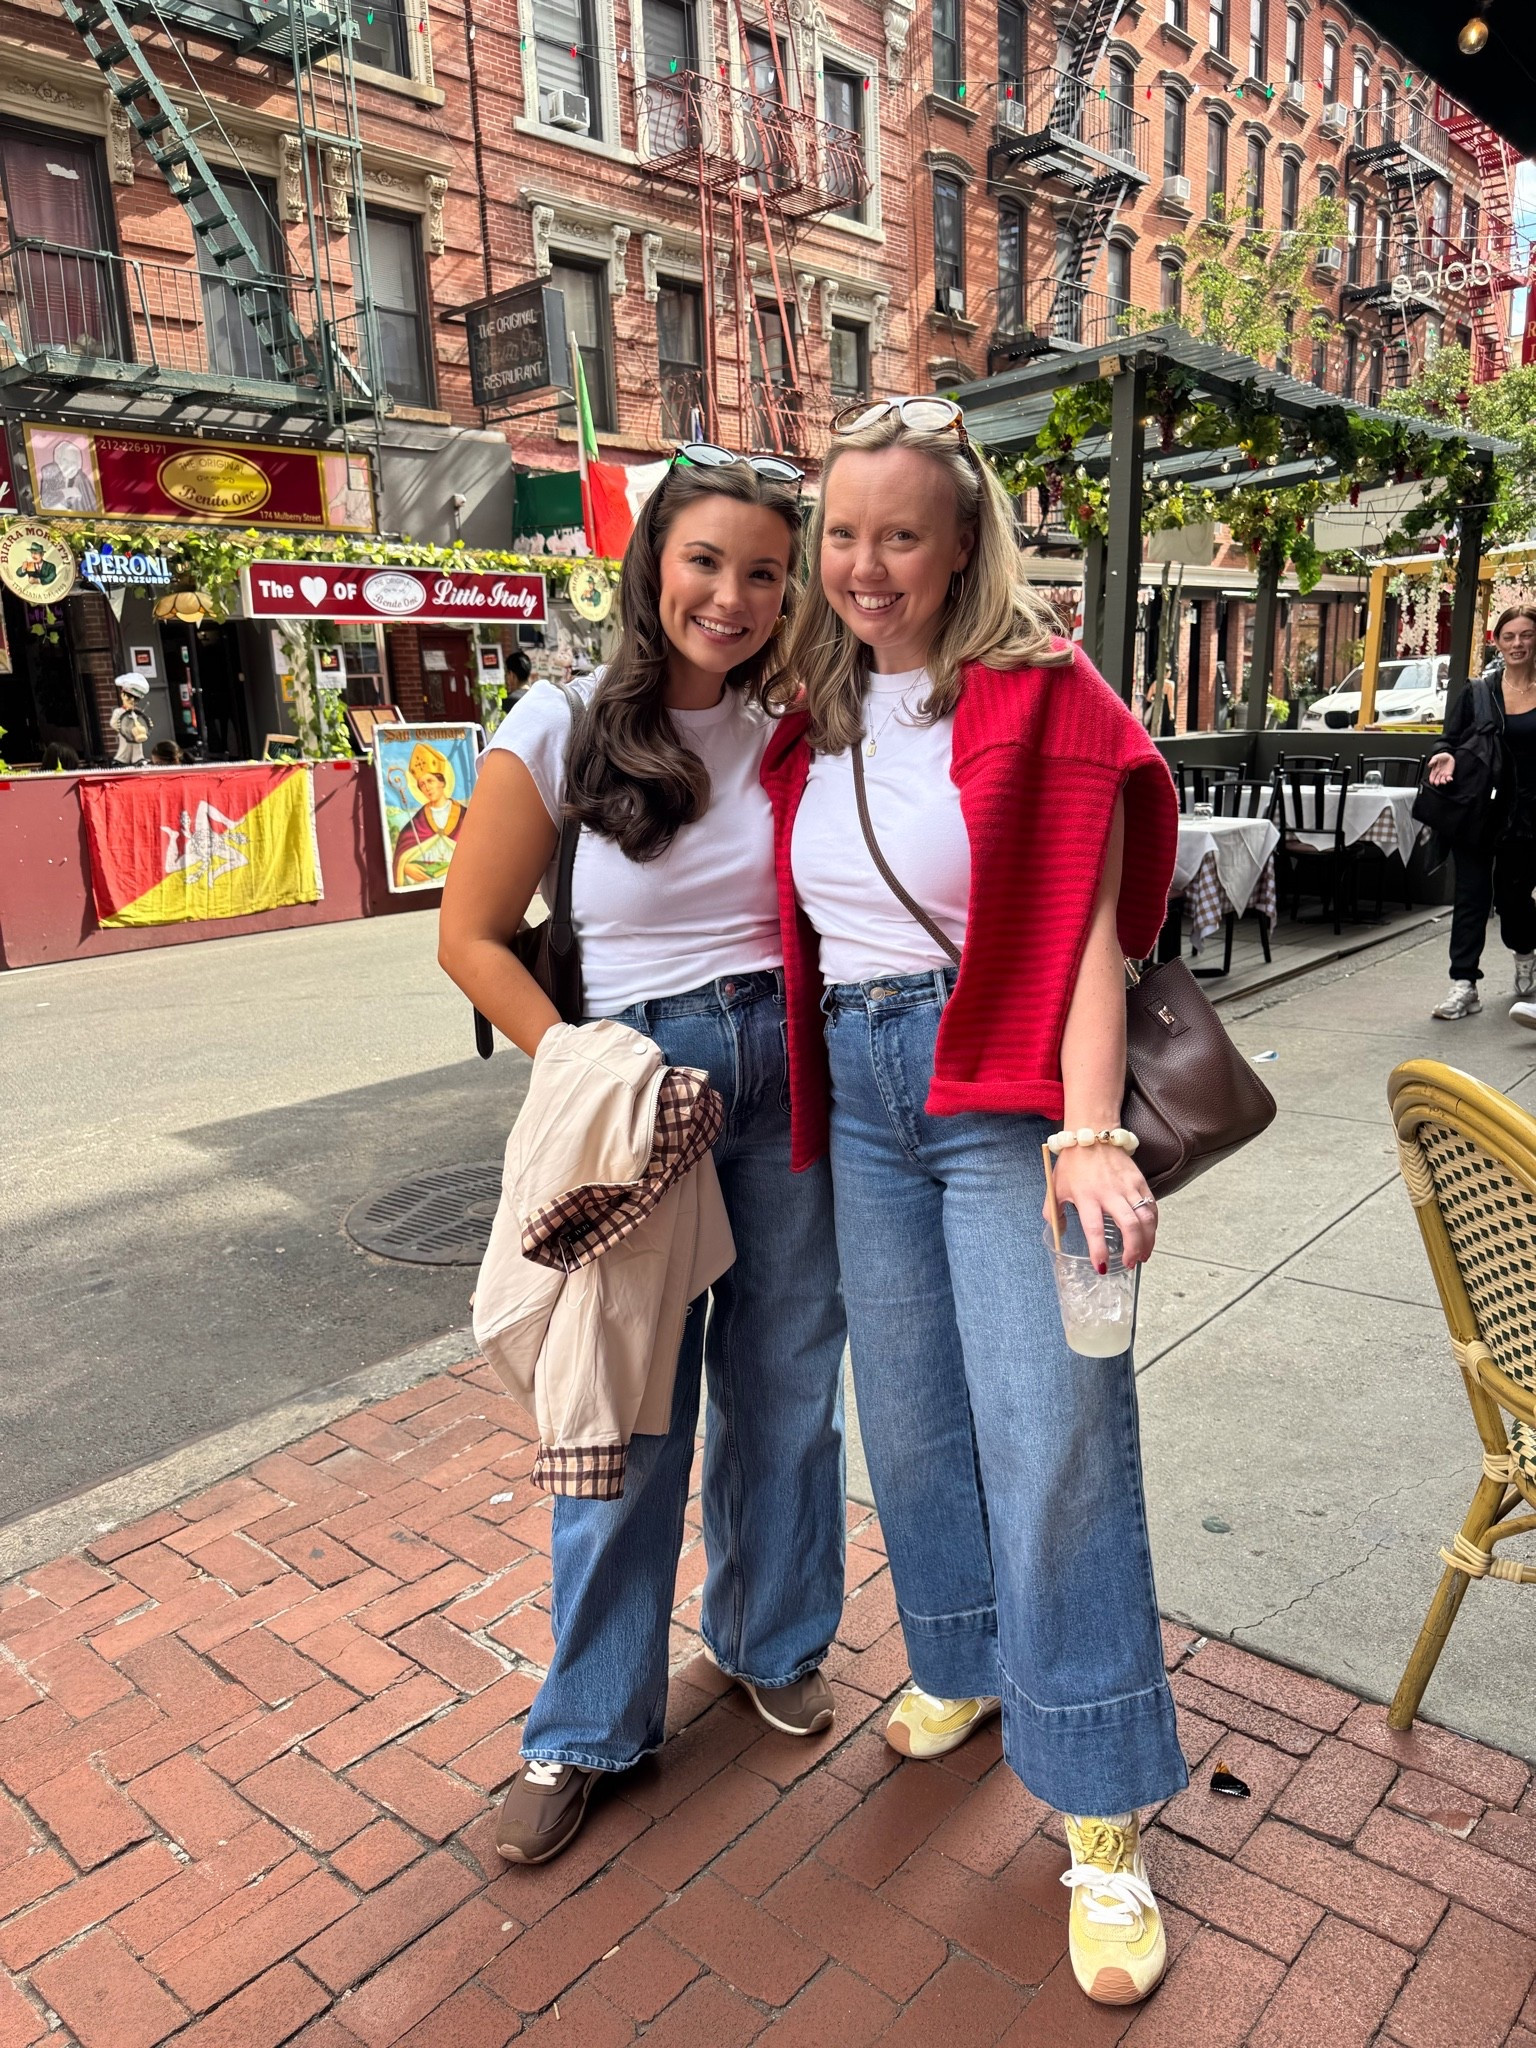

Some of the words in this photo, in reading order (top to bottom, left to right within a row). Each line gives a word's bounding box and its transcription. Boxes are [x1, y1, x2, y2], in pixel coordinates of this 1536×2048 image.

[478, 321, 496, 339] THE
[496, 308, 537, 333] ORIGINAL
[482, 361, 542, 390] RESTAURANT
[100, 439, 167, 454] 212-226-9171
[179, 458, 196, 470] THE
[199, 458, 245, 476] ORIGINAL
[179, 484, 229, 507] Benito
[232, 490, 257, 506] One
[260, 510, 273, 519] 174
[273, 511, 302, 522] Mulberry
[302, 513, 321, 522] Street
[1, 530, 24, 564] BIRRA
[84, 551, 168, 577] PERONI
[87, 574, 126, 583] NASTRO
[127, 576, 171, 585] AZZURRO
[258, 580, 294, 599] The
[333, 582, 357, 600] OF
[432, 578, 486, 607] Little
[487, 581, 538, 617] Italy
